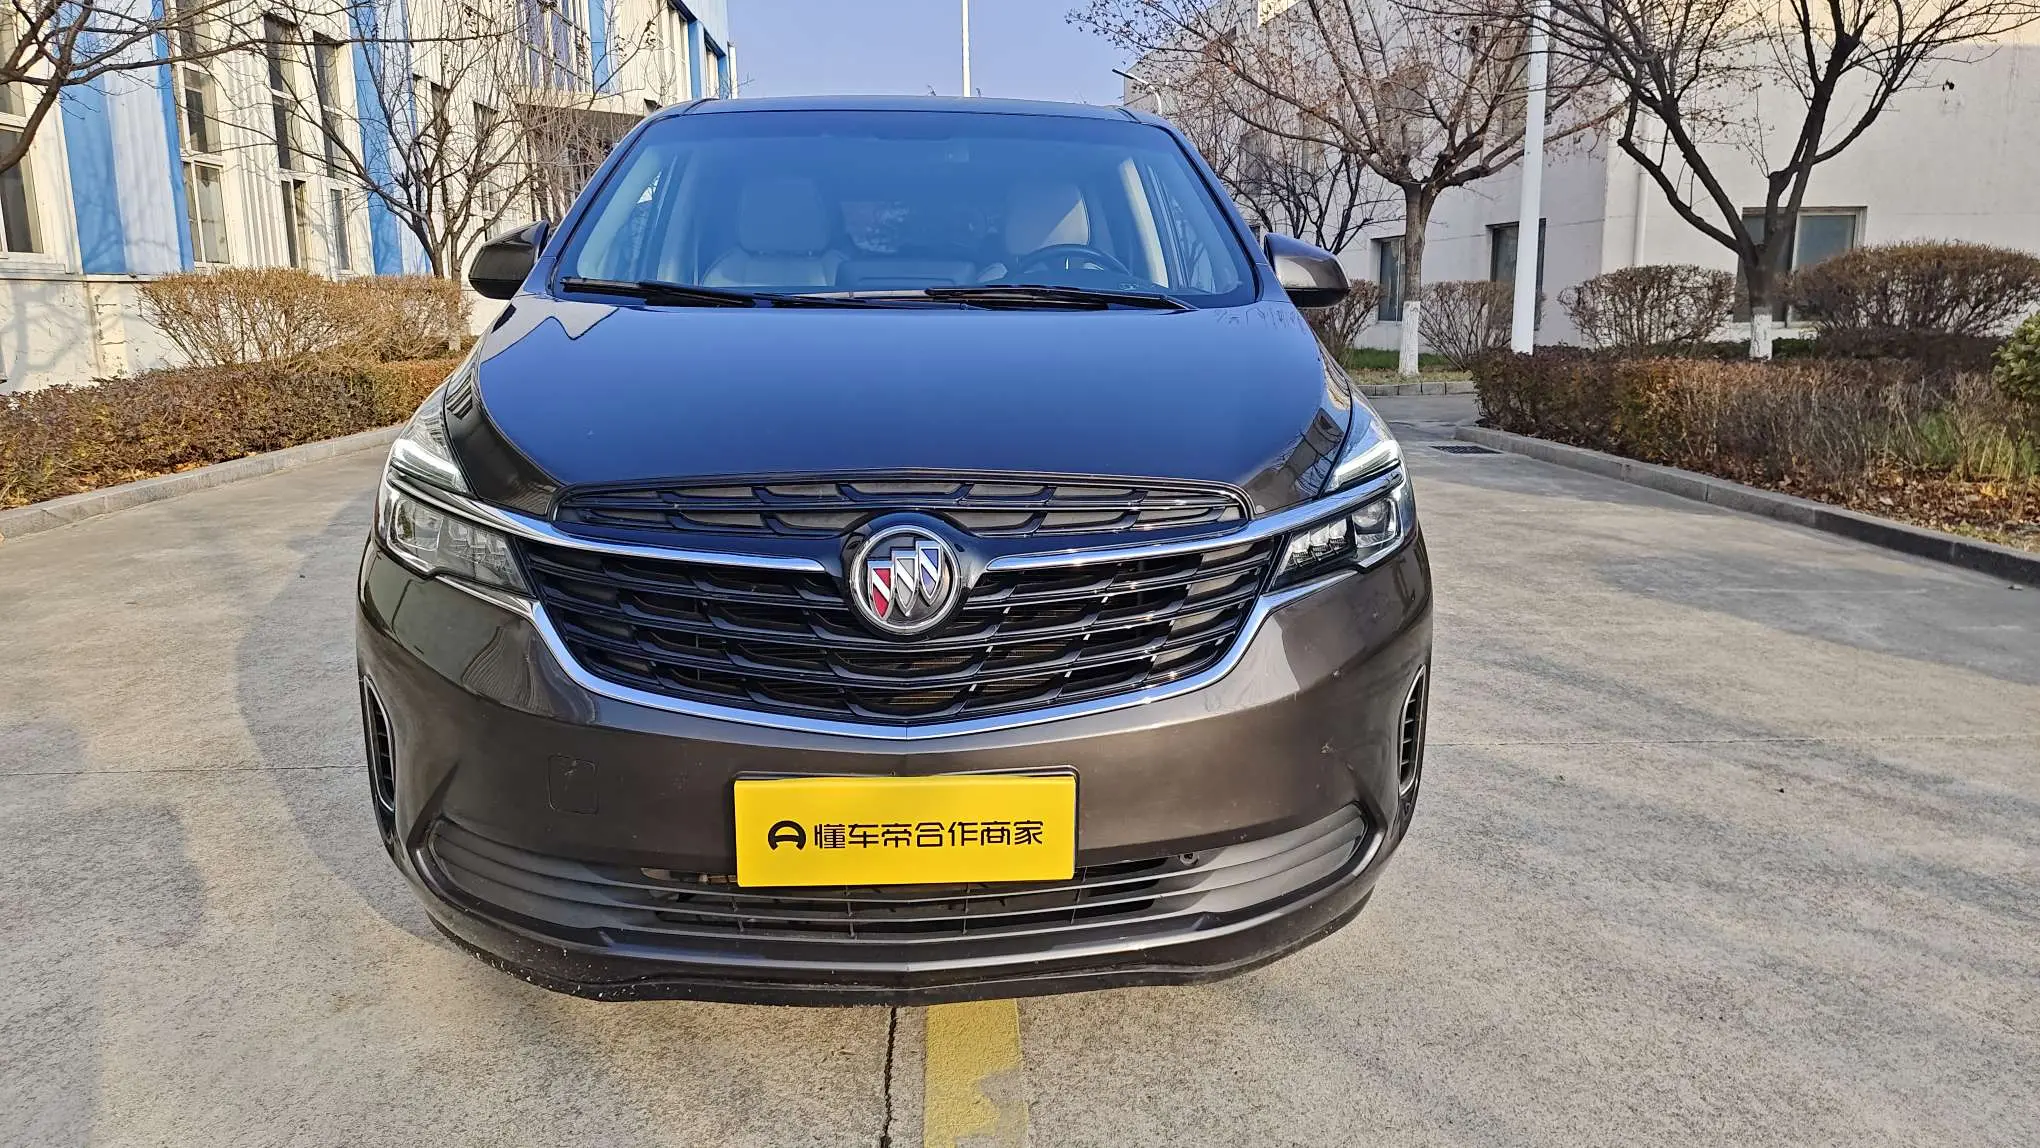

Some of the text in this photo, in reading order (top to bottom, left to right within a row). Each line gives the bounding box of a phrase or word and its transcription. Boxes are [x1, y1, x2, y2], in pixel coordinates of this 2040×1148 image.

[814, 820, 1044, 849] 懂车帝合作商家
